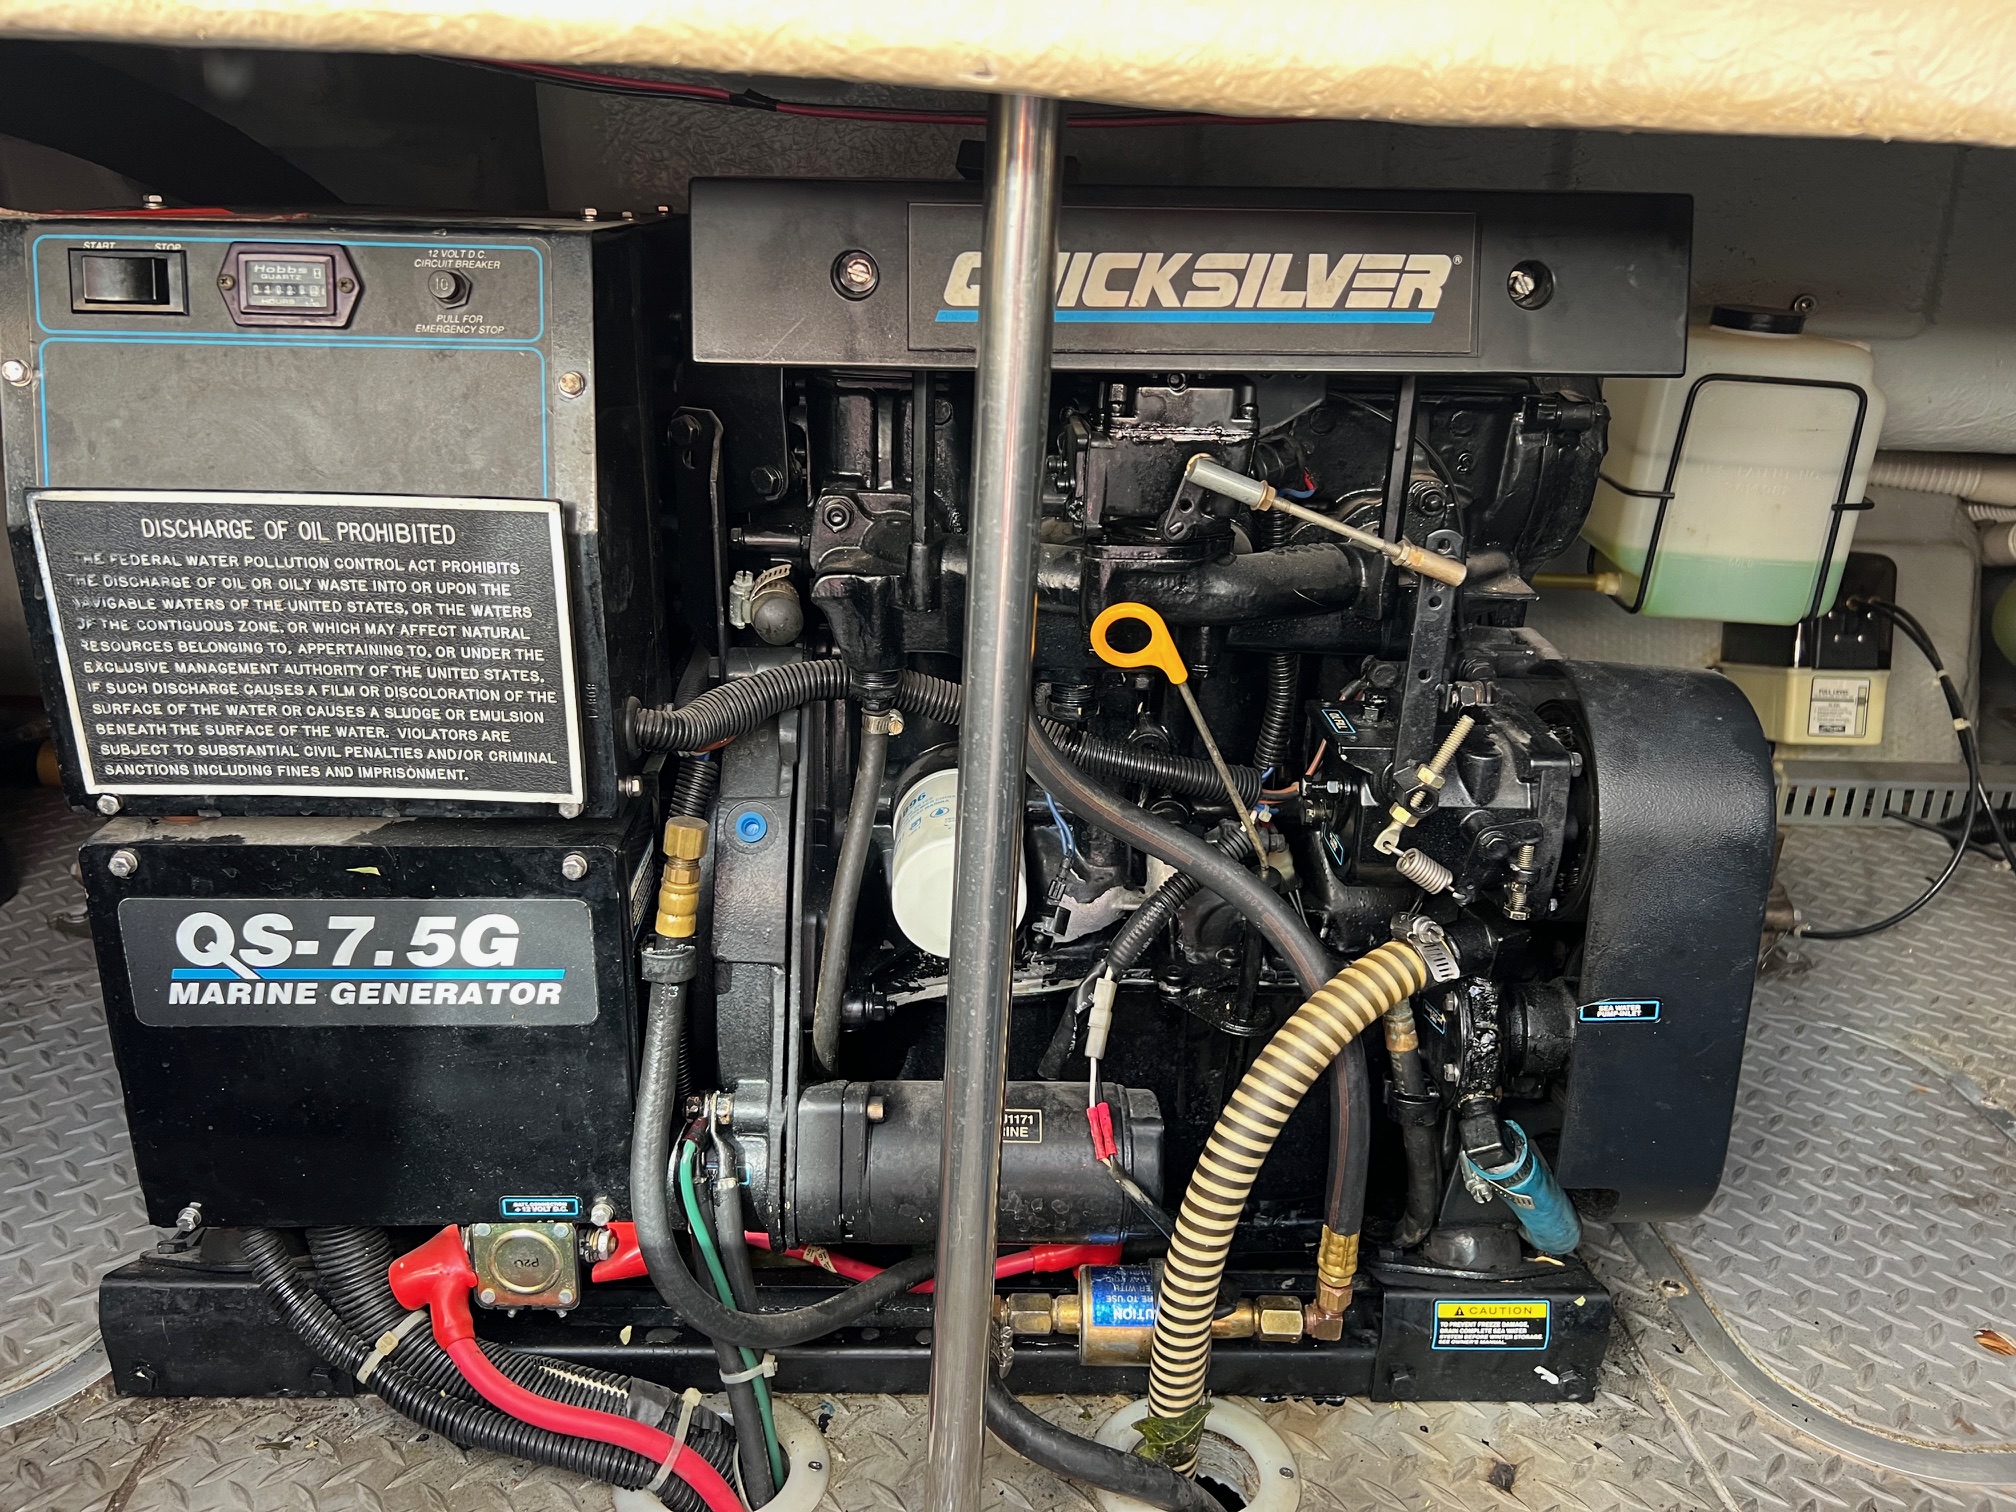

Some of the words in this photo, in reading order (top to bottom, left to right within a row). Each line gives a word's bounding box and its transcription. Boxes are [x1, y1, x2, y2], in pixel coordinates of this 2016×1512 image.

[441, 250, 466, 258] VOLT
[254, 265, 308, 273] Hobbs
[414, 259, 453, 268] CIRCUIT
[455, 261, 500, 269] BREAKER
[435, 278, 448, 290] 10
[437, 315, 460, 323] PULL
[463, 315, 483, 323] FOR
[415, 324, 477, 333] EMERGENCY
[479, 326, 504, 334] STOP
[140, 518, 255, 540] DISCHARGE
[264, 520, 289, 540] OF
[298, 521, 332, 542] OIL
[337, 522, 456, 545] PROHIBITED
[110, 554, 182, 567] FEDERAL
[186, 555, 239, 567] WATER
[244, 557, 330, 570] POLLUTION
[334, 558, 405, 571] CONTROL
[408, 560, 436, 572] ACT
[442, 561, 520, 574] PROHIBITS
[104, 575, 191, 589] DISCHARGE
[197, 577, 216, 589] OF
[222, 577, 247, 589] OIL
[251, 578, 272, 590] OR
[278, 578, 312, 592] OILY
[318, 579, 368, 592] WASTE
[373, 580, 407, 593] INTO
[412, 581, 432, 593] OR
[436, 583, 477, 595] UPON
[481, 584, 511, 596] THE
[162, 599, 226, 610] WATERS
[230, 599, 249, 610] OF
[253, 599, 285, 611] THE
[288, 600, 342, 612] UNITED
[347, 601, 409, 616] STATES,
[412, 603, 432, 615] OR
[436, 603, 466, 616] THE
[471, 605, 533, 618] WATERS
[100, 619, 130, 631] THE
[137, 620, 234, 632] CONTIGUOUS
[238, 621, 285, 634] ZONE,
[288, 622, 308, 633] OR
[312, 622, 360, 634] WHICH
[365, 623, 396, 636] MAY
[400, 624, 456, 638] AFFECT
[462, 626, 530, 639] NATURAL
[81, 640, 173, 653] RESOURCES
[178, 641, 263, 654] BELONGING
[298, 644, 404, 658] APPERTAINING
[435, 646, 455, 658] OR
[461, 647, 511, 660] UNDER
[514, 649, 544, 661] THE
[84, 661, 170, 674] EXCLUSIVE
[175, 662, 279, 675] MANAGEMENT
[284, 664, 364, 676] AUTHORITY
[370, 665, 389, 677] OF
[392, 666, 422, 679] THE
[427, 667, 479, 680] UNITED
[88, 682, 101, 693] IF
[106, 682, 148, 694] SUCH
[152, 683, 239, 695] DISCHARGE
[244, 684, 303, 696] CAUSES
[308, 685, 317, 696] A
[322, 685, 355, 697] FILM
[360, 685, 380, 698] OR
[385, 687, 500, 702] DISCOLORATION
[504, 690, 524, 702] OF
[527, 690, 557, 703] THE
[93, 703, 163, 715] SURFACE
[166, 704, 186, 715] OF
[190, 704, 221, 716] THE
[225, 704, 278, 716] WATER
[282, 705, 302, 717] OR
[306, 706, 365, 718] CAUSES
[370, 706, 380, 718] A
[385, 707, 441, 720] SLUDGE
[445, 708, 466, 721] OR
[470, 709, 544, 723] EMULSION
[96, 723, 167, 736] BENEATH
[170, 724, 200, 736] THE
[205, 724, 273, 737] SURFACE
[279, 725, 298, 737] OF
[302, 726, 331, 738] THE
[336, 726, 389, 739] WATER.
[397, 728, 478, 741] VIOLATORS
[482, 730, 511, 742] ARE
[101, 744, 170, 756] SUBJECT
[174, 745, 194, 756] TO
[198, 745, 300, 757] SUBSTANTIAL
[304, 746, 342, 758] CIVIL
[345, 747, 423, 759] PENALTIES
[427, 748, 484, 762] AND/OR
[488, 750, 558, 764] CRIMINAL
[105, 764, 190, 776] SANCTIONS
[194, 765, 272, 776] INCLUDING
[278, 766, 320, 778] FINES
[325, 766, 353, 778] AND
[358, 767, 469, 781] IMPRISONMENT.
[169, 982, 318, 1006] MARINE
[330, 983, 563, 1005] GENERATOR
[1469, 1306, 1532, 1315] CAUTION
